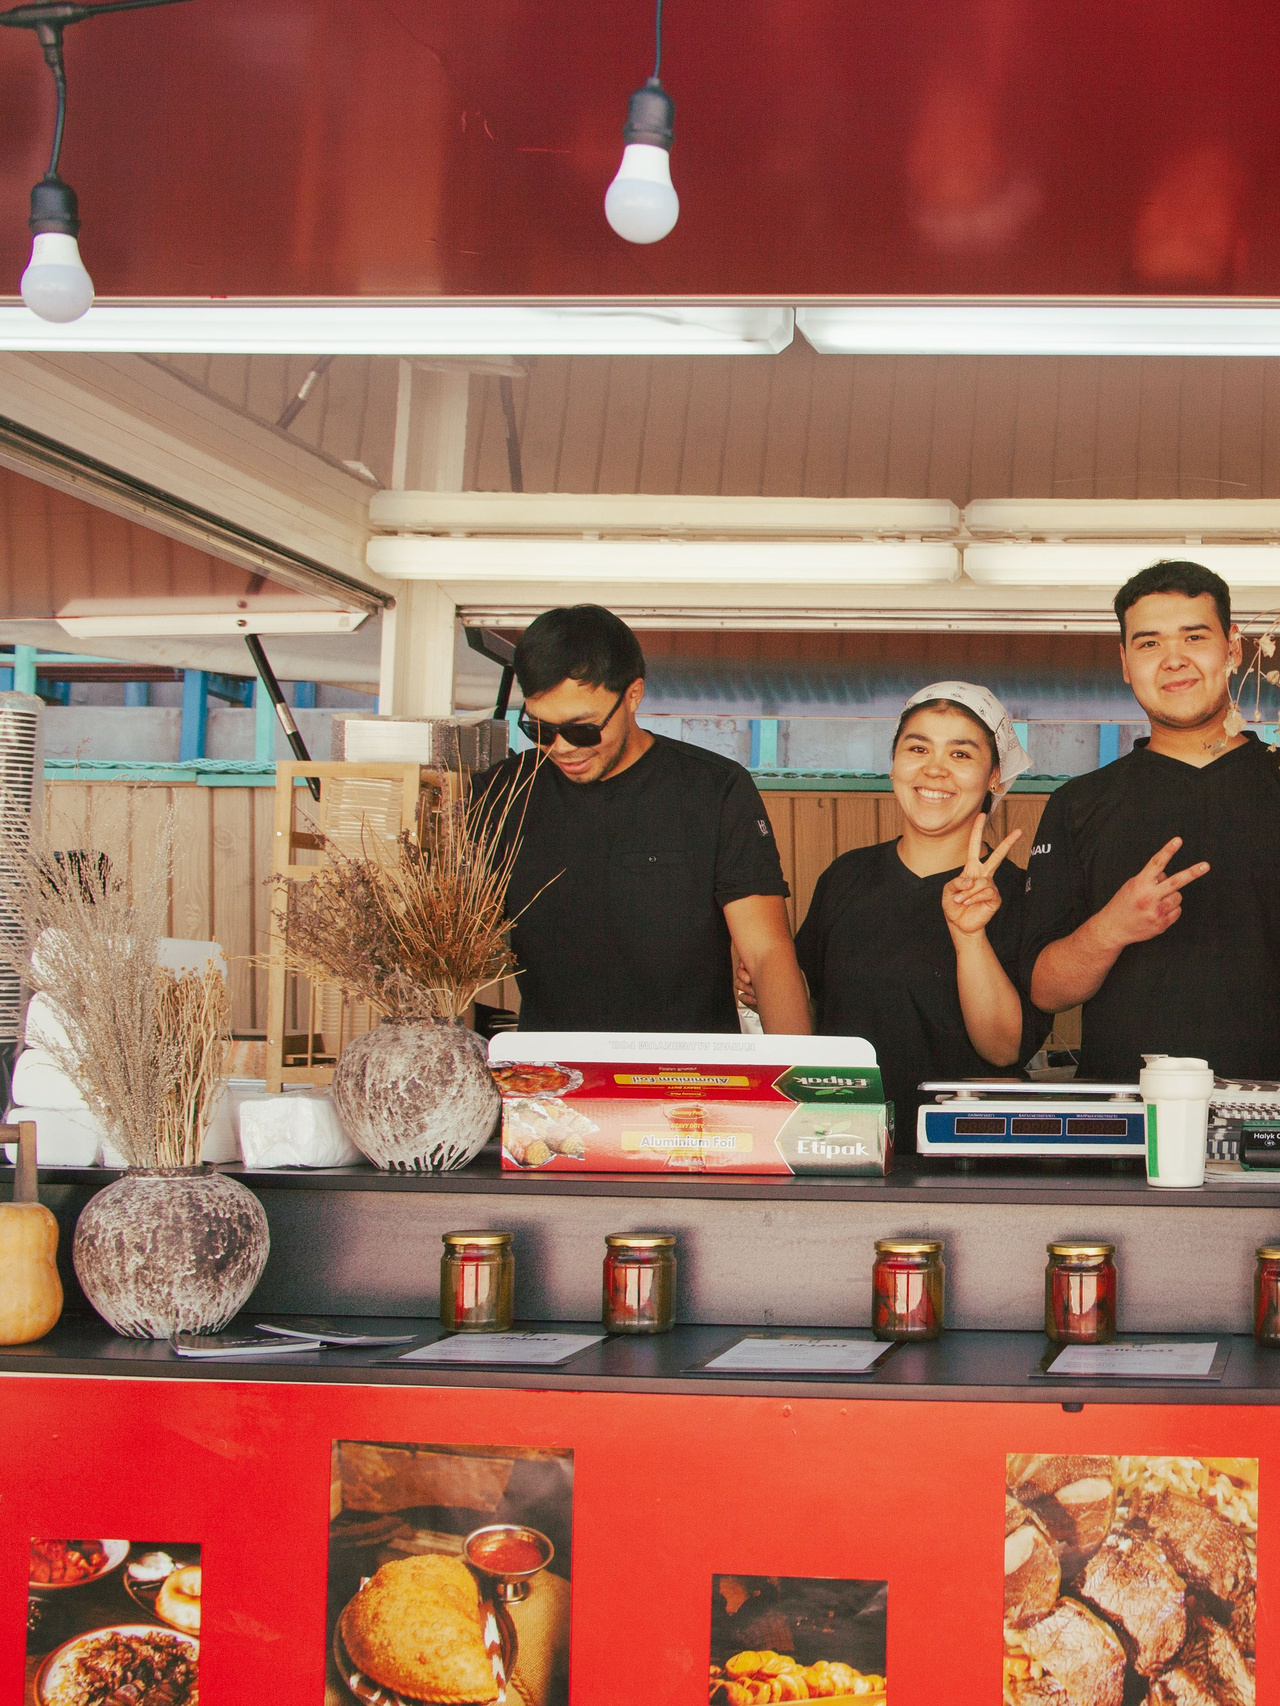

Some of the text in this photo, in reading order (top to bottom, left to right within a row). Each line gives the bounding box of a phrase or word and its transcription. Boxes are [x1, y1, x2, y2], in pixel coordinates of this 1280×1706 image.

[630, 1075, 730, 1085] Aluminium Foil
[793, 1075, 868, 1087] Etipak
[640, 1135, 736, 1148] Aluminium Foil
[797, 1139, 870, 1159] Etipak
